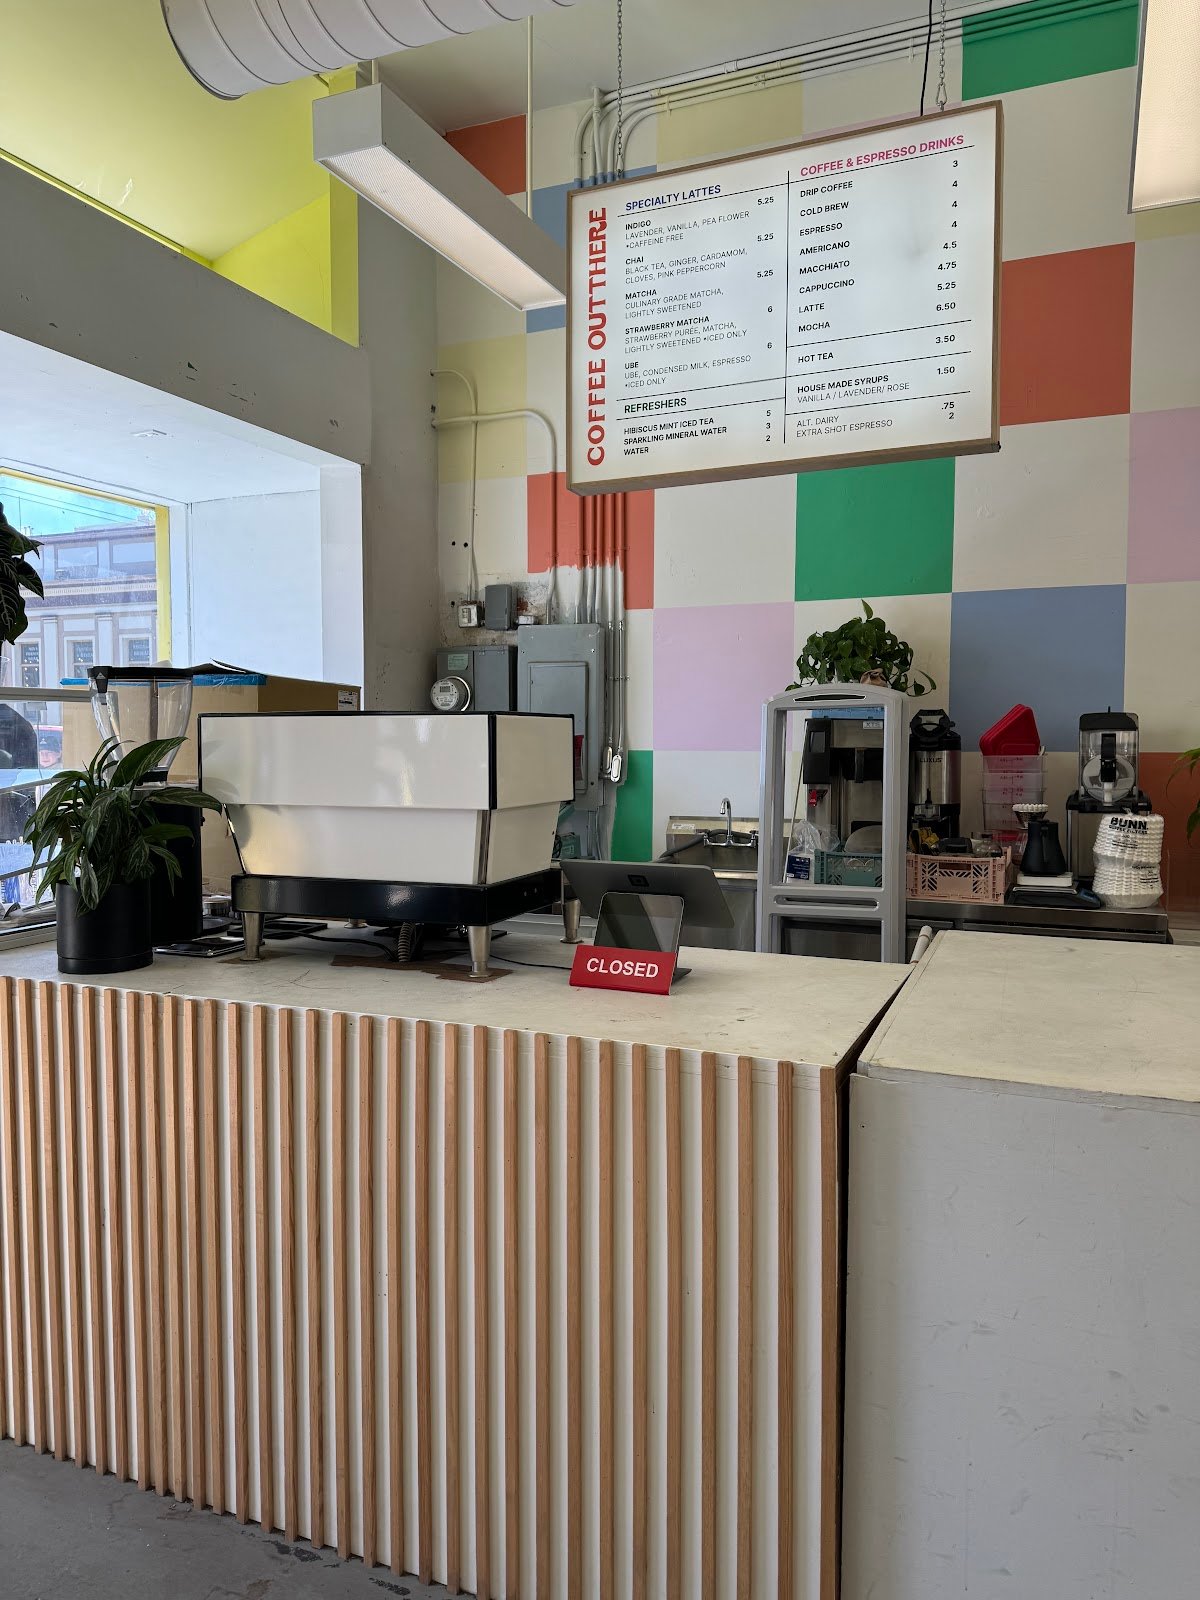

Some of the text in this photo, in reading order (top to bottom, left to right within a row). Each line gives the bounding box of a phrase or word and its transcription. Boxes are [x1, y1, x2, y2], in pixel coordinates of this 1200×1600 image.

[800, 135, 964, 177] COFFEE & ESPRESSO DRINKS
[800, 160, 958, 198] DRIP COFFEE 3
[625, 185, 721, 211] SPECIALTY LATTES
[800, 206, 823, 217] COLD
[825, 202, 849, 212] BREW
[625, 196, 774, 230] INDIGO 5.25
[625, 211, 750, 241] LAVENDER, VANILLA, PEA FLOWER
[666, 233, 684, 242] FREE
[800, 222, 843, 237] ESPRESSO
[625, 233, 774, 265] CHAI 5.25
[799, 241, 850, 256] AMERICANO
[799, 241, 957, 275] MACCHIATO 4.5
[625, 248, 748, 275] BLACK TEA, GINGER, CARDAMOM,
[625, 262, 726, 285] CLOVES, PINK PEPPERCORN
[625, 269, 774, 300] MATCHA 5.25
[799, 261, 957, 294] CAPPUCCINO 4.75
[625, 288, 724, 310] CULINARY GRADE MATCHA,
[798, 282, 956, 313] LATTE 5.25
[625, 301, 702, 319] LIGHTLY SWEETENED
[798, 302, 956, 333] MOCHA 6.50
[587, 207, 607, 466] COFFEE OUTTHERE
[625, 321, 675, 335] STRAWBERRY
[677, 316, 710, 327] MATCHA
[625, 331, 673, 345] STRAWBERRY
[703, 322, 737, 333] MATCHA,
[625, 343, 655, 354] LIGHTLY
[657, 336, 701, 349] SWEETENED
[727, 330, 748, 339] ONLY
[798, 335, 956, 363] HOT TEA 3.50
[625, 361, 639, 370] UBE
[625, 355, 751, 380] UBE, CONDENSED MILK, ESPRESSO
[646, 377, 667, 386] ONLY
[797, 366, 955, 393] HOUSE MADE SYRUPS 1.50
[797, 393, 831, 403] VANILLA
[887, 383, 910, 392] ROSE
[624, 398, 687, 414] REFRESHERS
[796, 402, 955, 428] ALT. DAIRY .75
[624, 424, 658, 435] HIBISCUS
[660, 422, 678, 430] MINT
[680, 420, 697, 428] ICED
[624, 434, 664, 446] SPARKLING
[666, 431, 699, 440] MINERAL
[701, 427, 727, 436] WATER
[796, 427, 823, 438] EXTRA
[825, 425, 847, 434] SHOT
[850, 419, 893, 431] ESPRESSO
[624, 447, 649, 456] WATER
[586, 957, 659, 978] CLOSED
